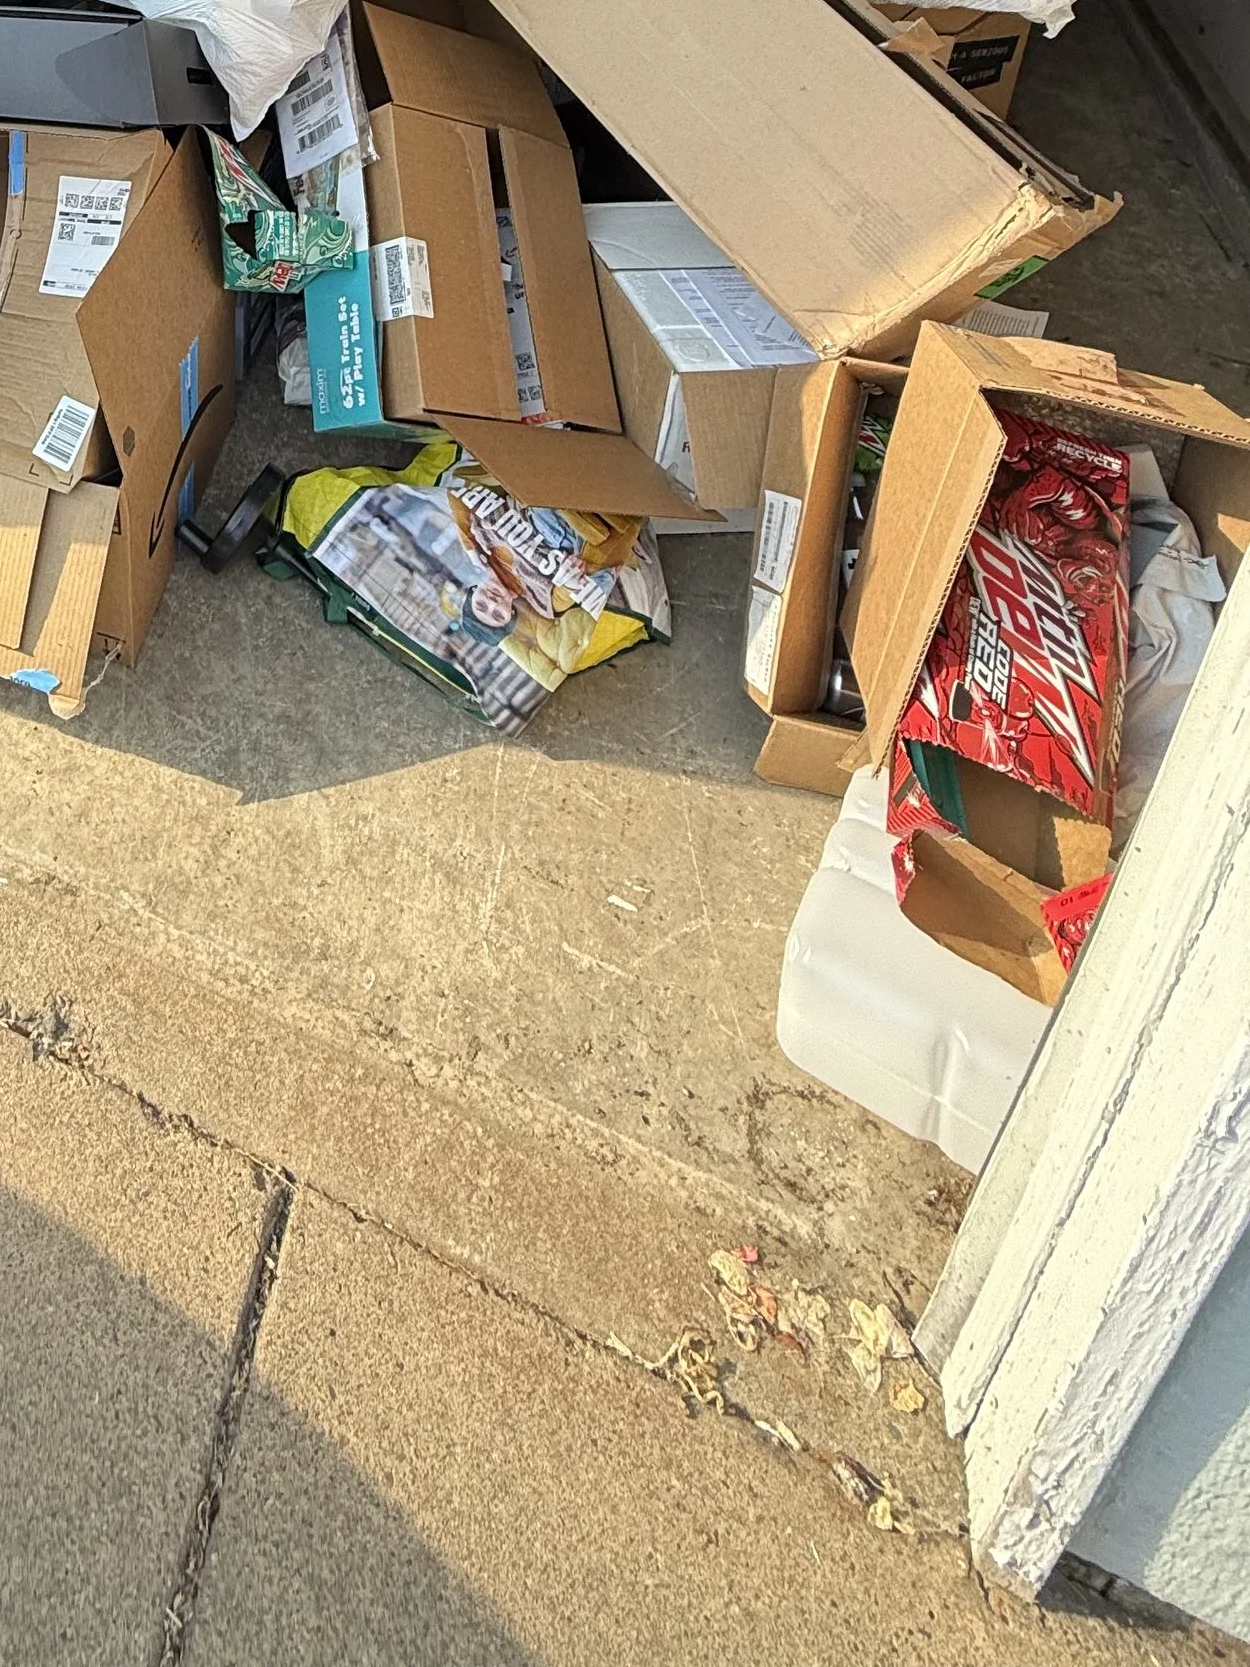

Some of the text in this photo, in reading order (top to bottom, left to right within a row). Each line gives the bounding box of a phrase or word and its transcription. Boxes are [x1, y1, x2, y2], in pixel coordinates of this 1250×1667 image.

[338, 296, 348, 321] Set
[340, 325, 351, 363] Train
[350, 303, 366, 407] w/ Play Table
[1056, 443, 1123, 473] RECYCLE
[493, 509, 546, 561] YOU
[973, 612, 998, 693] RED
[992, 639, 1010, 711] CODE
